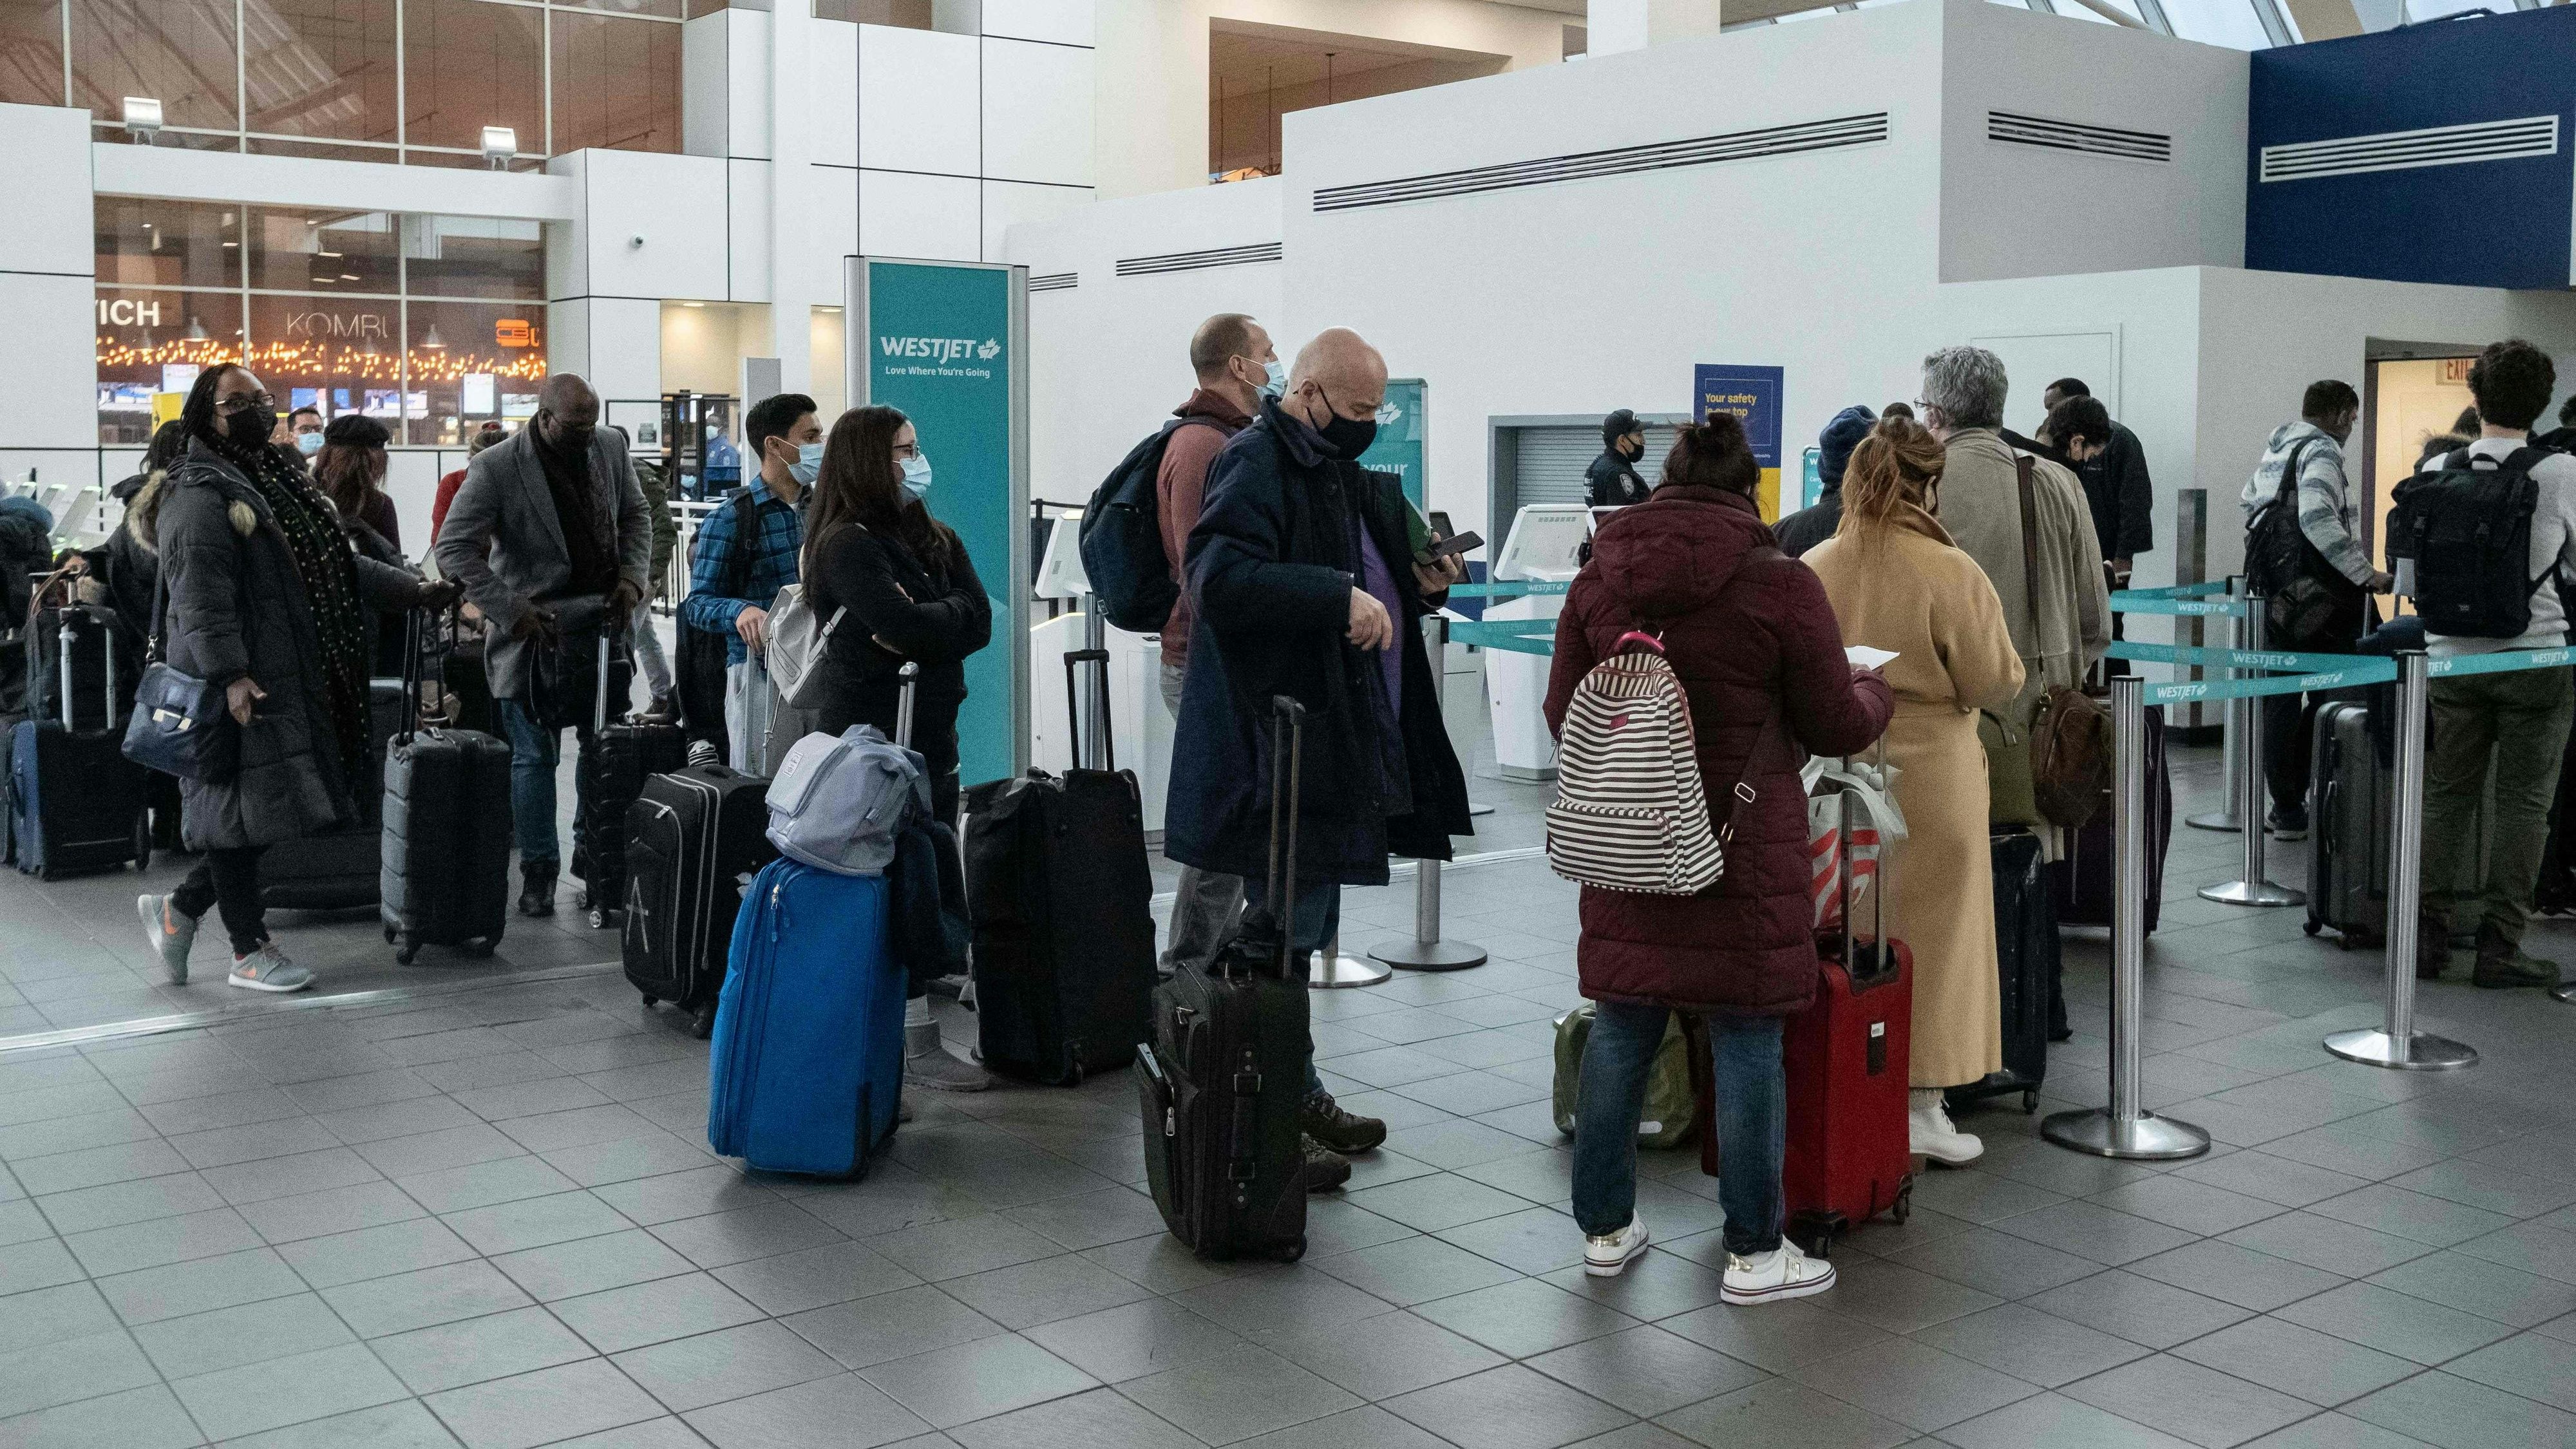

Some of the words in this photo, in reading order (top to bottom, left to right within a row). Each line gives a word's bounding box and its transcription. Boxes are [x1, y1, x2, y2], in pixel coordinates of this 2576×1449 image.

[95, 299, 160, 327] ICH
[880, 337, 976, 365] WESTJET
[886, 366, 906, 375] Love
[908, 366, 936, 375] Where
[938, 367, 963, 376] You're
[966, 368, 990, 378] Going
[1705, 393, 1725, 402] Your
[1727, 393, 1757, 406] safety
[1732, 407, 1748, 418] top
[1527, 583, 1557, 592] WESTJET
[2177, 603, 2218, 612] WESTJET
[2232, 652, 2283, 668] WESTJET
[2532, 652, 2563, 667] WESTJET
[2428, 661, 2445, 676] TJET
[2300, 674, 2337, 688] WESTJET
[2157, 685, 2196, 700] WESTJET
